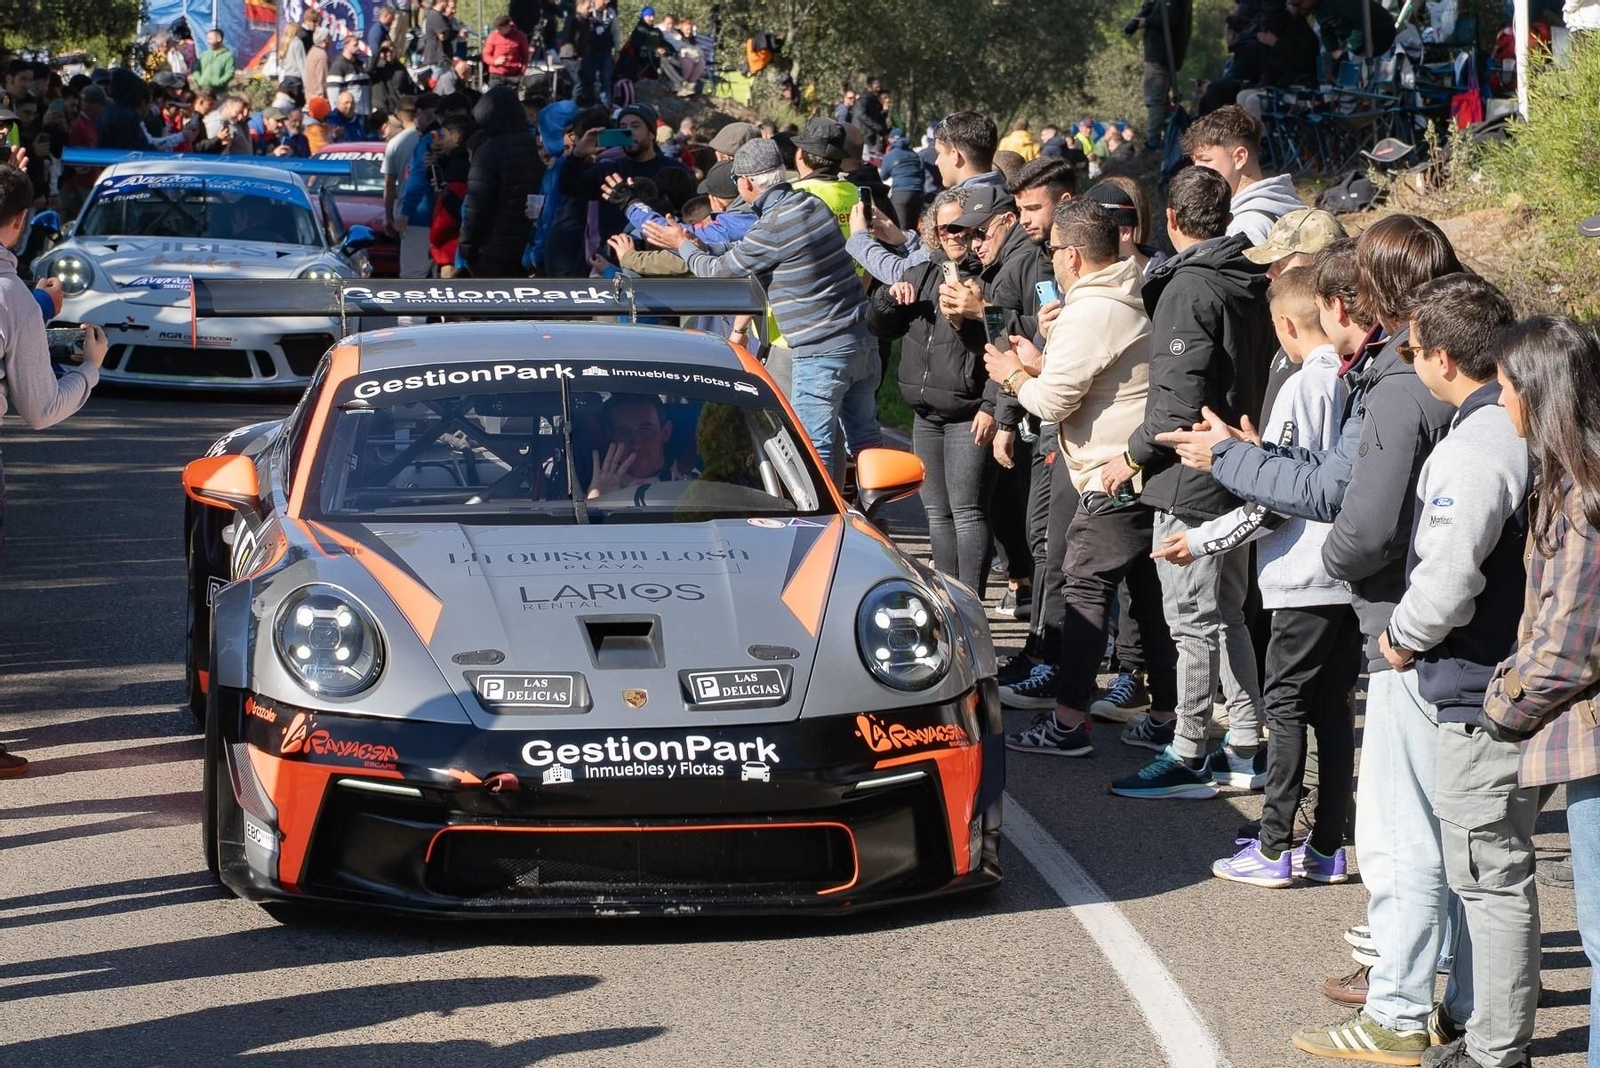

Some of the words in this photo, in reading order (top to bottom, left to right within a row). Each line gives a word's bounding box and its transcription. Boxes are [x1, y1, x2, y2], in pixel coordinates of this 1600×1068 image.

[344, 286, 614, 300] GestionPark
[354, 363, 575, 399] GestionPark
[612, 368, 680, 380] Inmuebles
[683, 375, 691, 383] y
[693, 375, 731, 388] Flotas
[1220, 522, 1253, 548] KELME
[507, 549, 750, 565] QUISQUILLOSA
[519, 583, 706, 603] LARIOS
[522, 601, 603, 611] RENTAL
[524, 679, 548, 688] LAS
[734, 673, 758, 683] LAS
[507, 691, 567, 702] DELICIAS
[722, 684, 780, 697] DELICIAS
[521, 735, 780, 767] GestionPark
[585, 762, 665, 779] Inmuebles
[668, 763, 677, 779] y
[680, 761, 725, 776] Flotas
